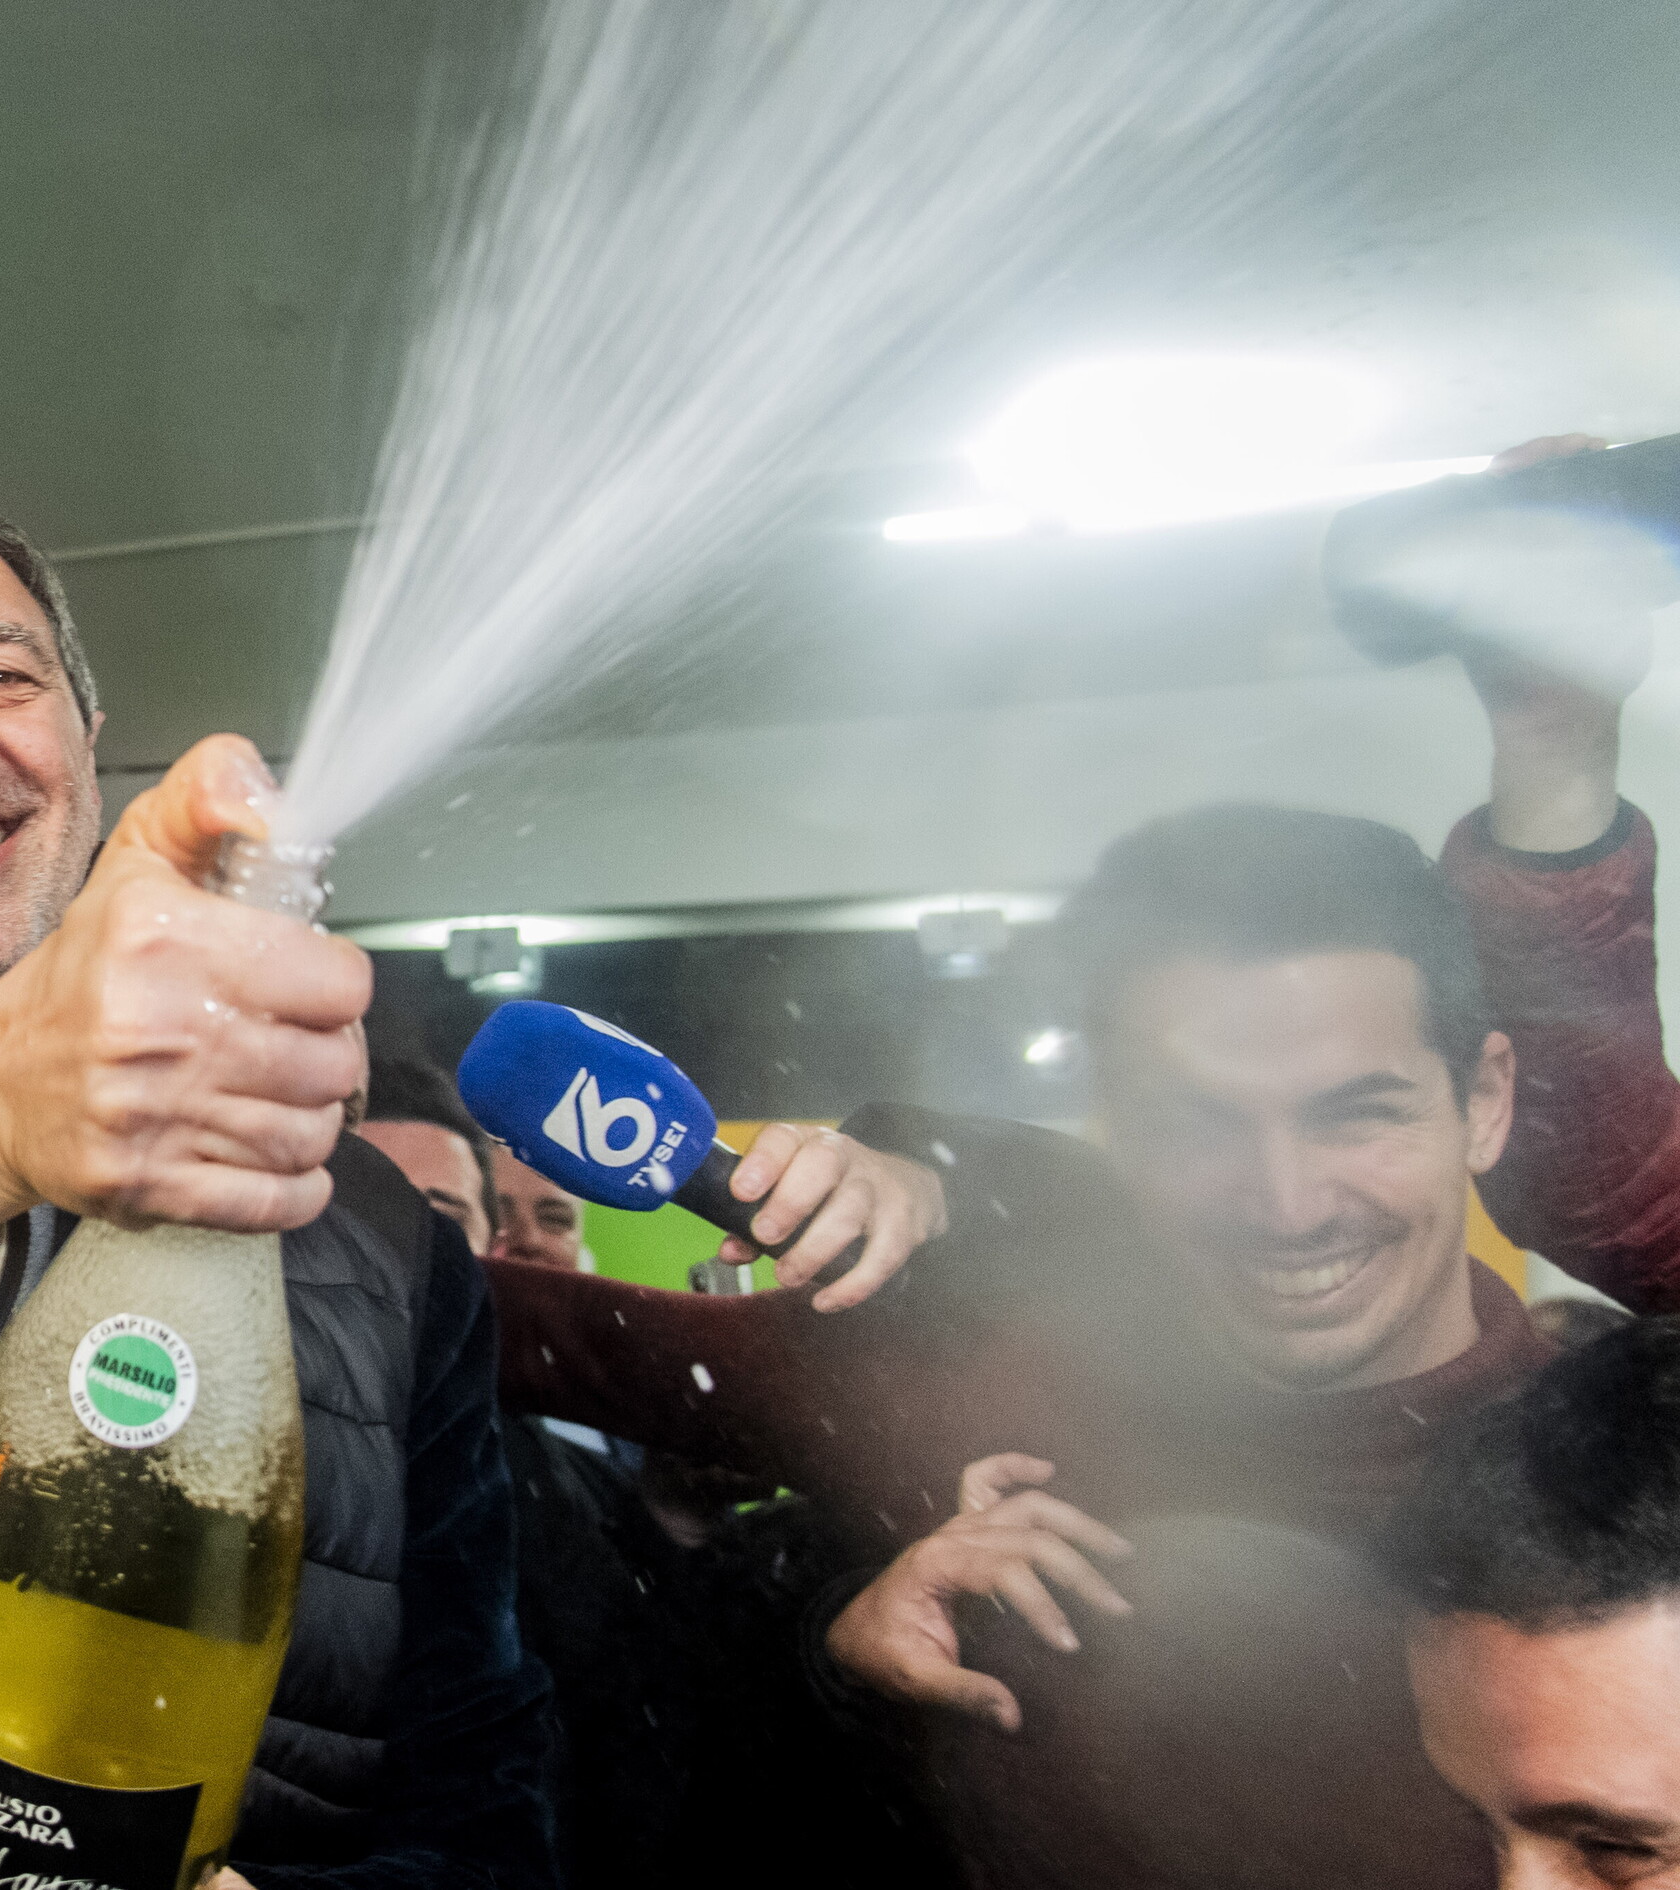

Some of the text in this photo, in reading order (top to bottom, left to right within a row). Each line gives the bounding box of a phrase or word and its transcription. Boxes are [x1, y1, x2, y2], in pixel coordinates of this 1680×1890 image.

[88, 1319, 192, 1379] COMPLIMENTI
[92, 1351, 177, 1395] MARSILIO
[74, 1390, 168, 1442] BRAVISSIMO
